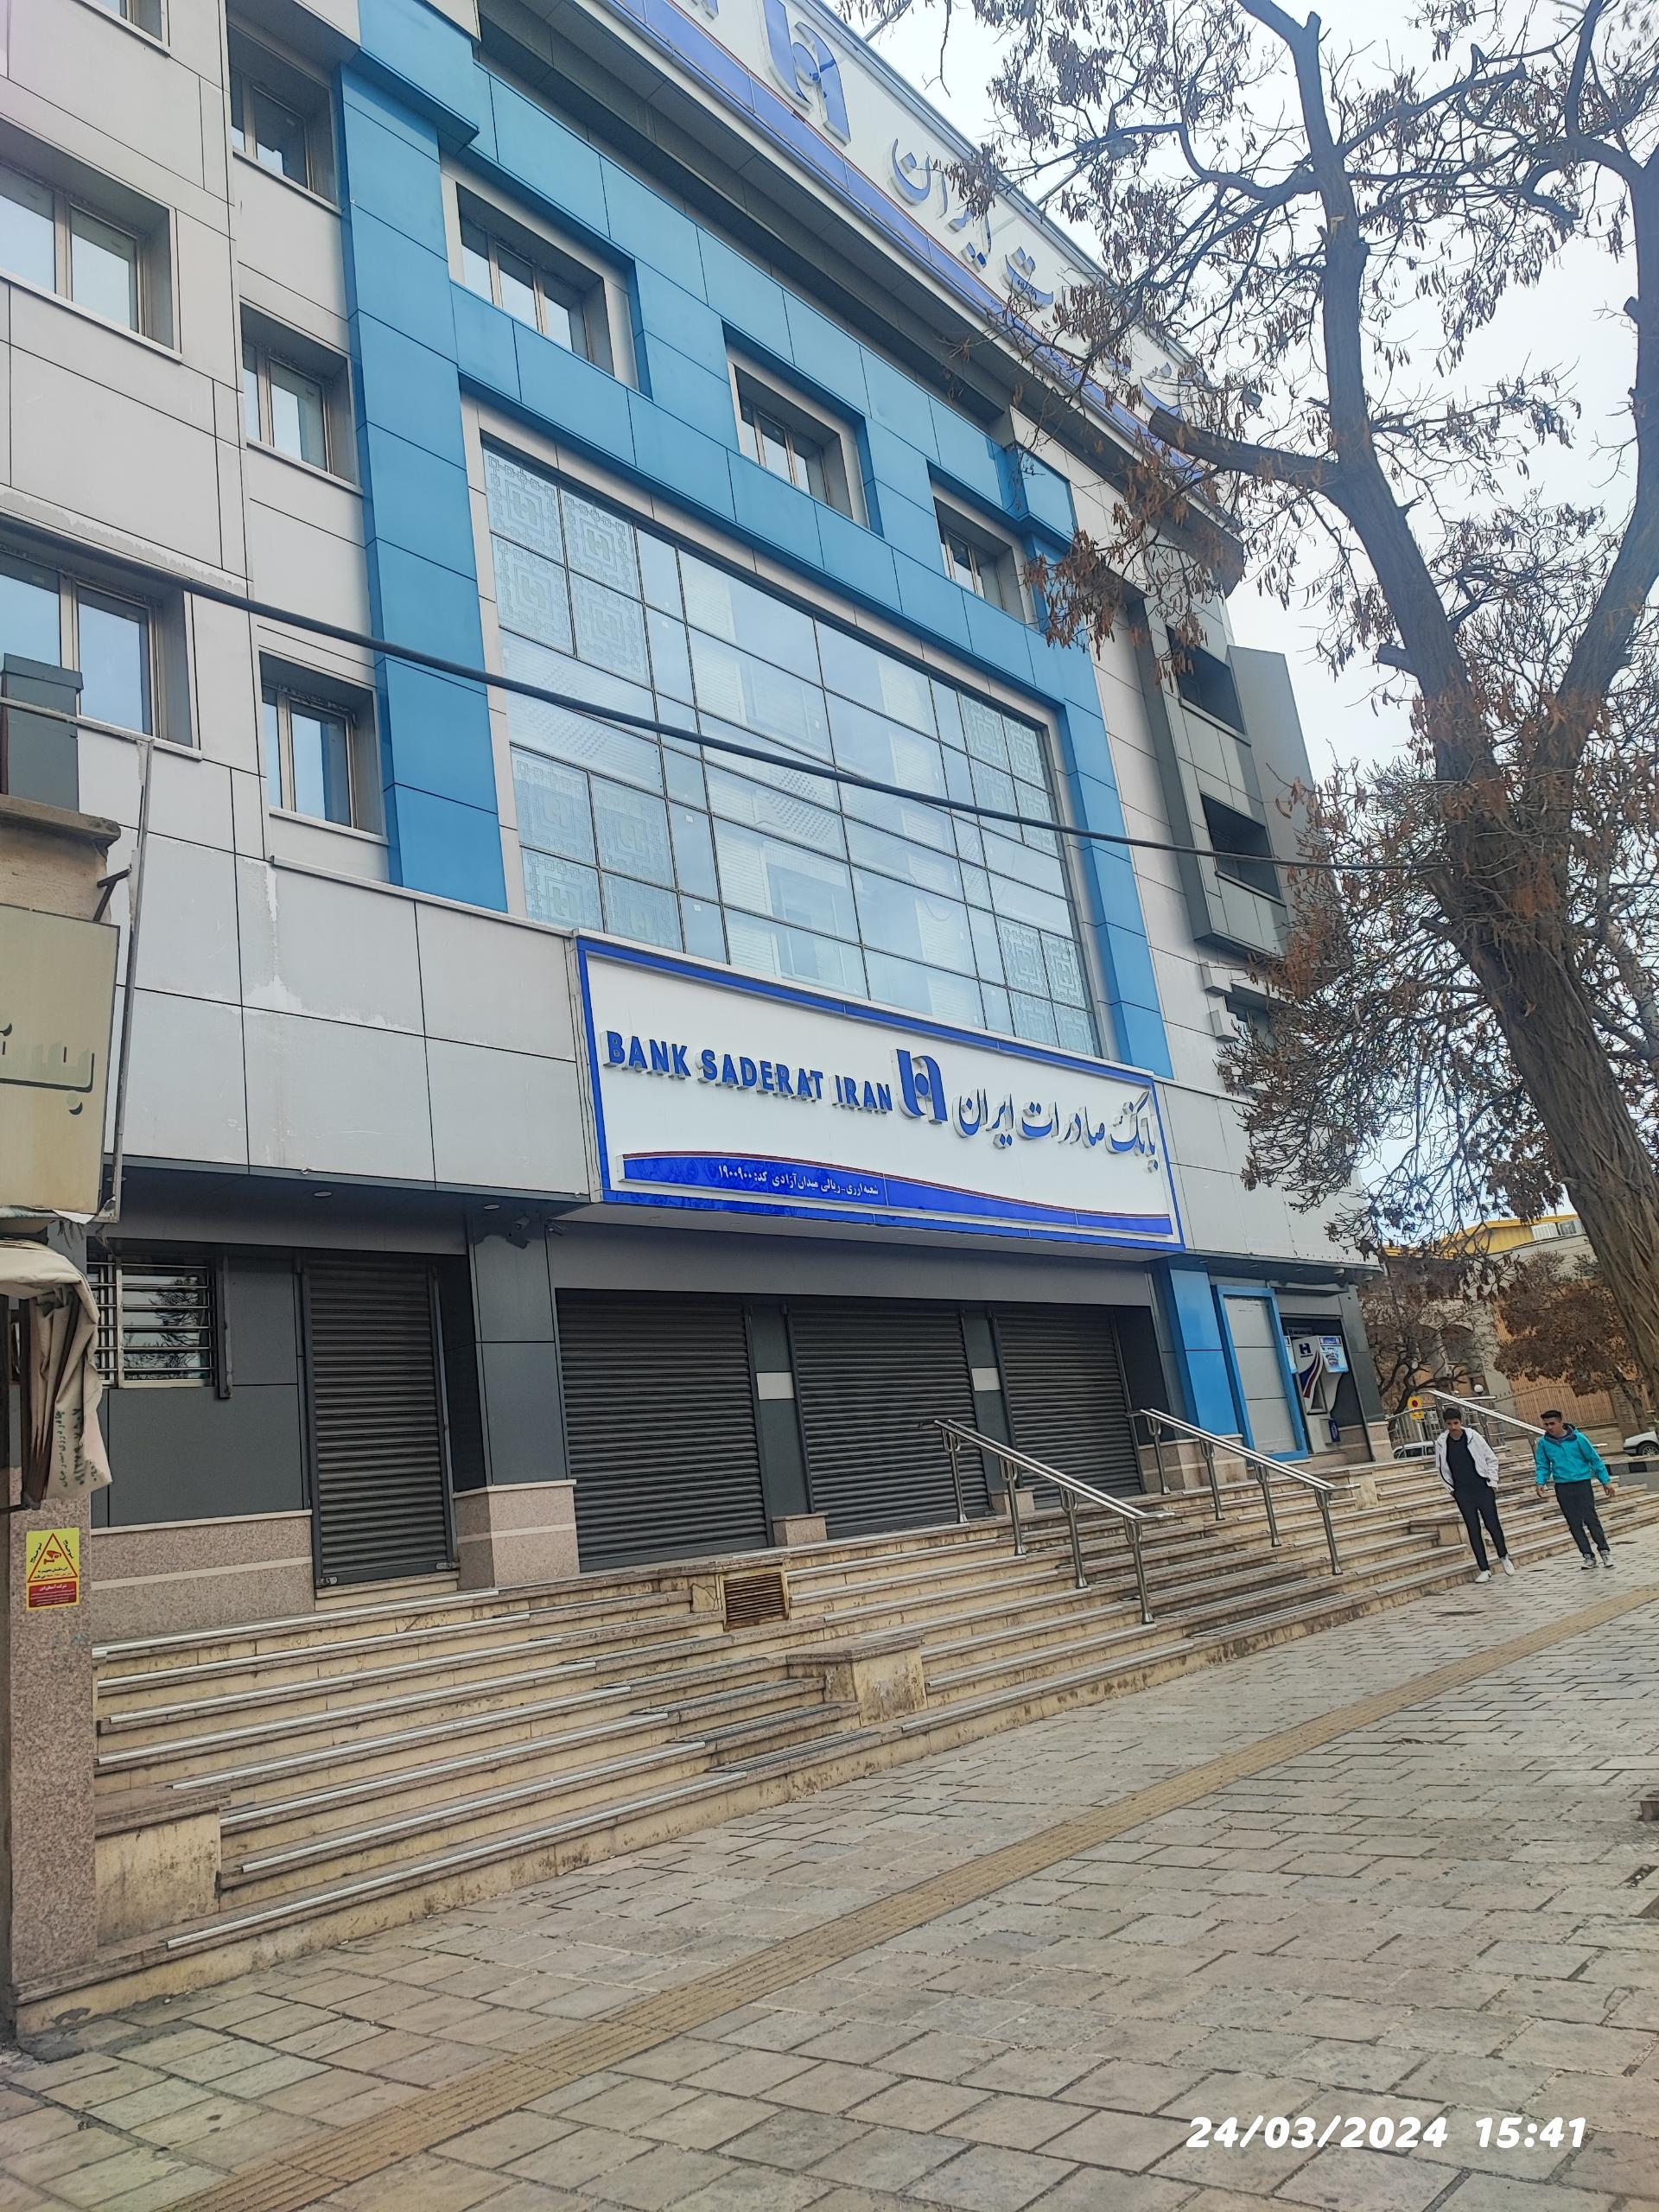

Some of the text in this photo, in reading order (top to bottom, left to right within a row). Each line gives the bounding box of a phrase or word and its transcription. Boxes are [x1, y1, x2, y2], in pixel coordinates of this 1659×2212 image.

[604, 1030, 893, 1112] BANK SADERAT IRAN
[957, 1088, 1159, 1173] بانک صادرات ایران
[772, 1172, 797, 1189] آزادی
[798, 1176, 819, 1191] میدان
